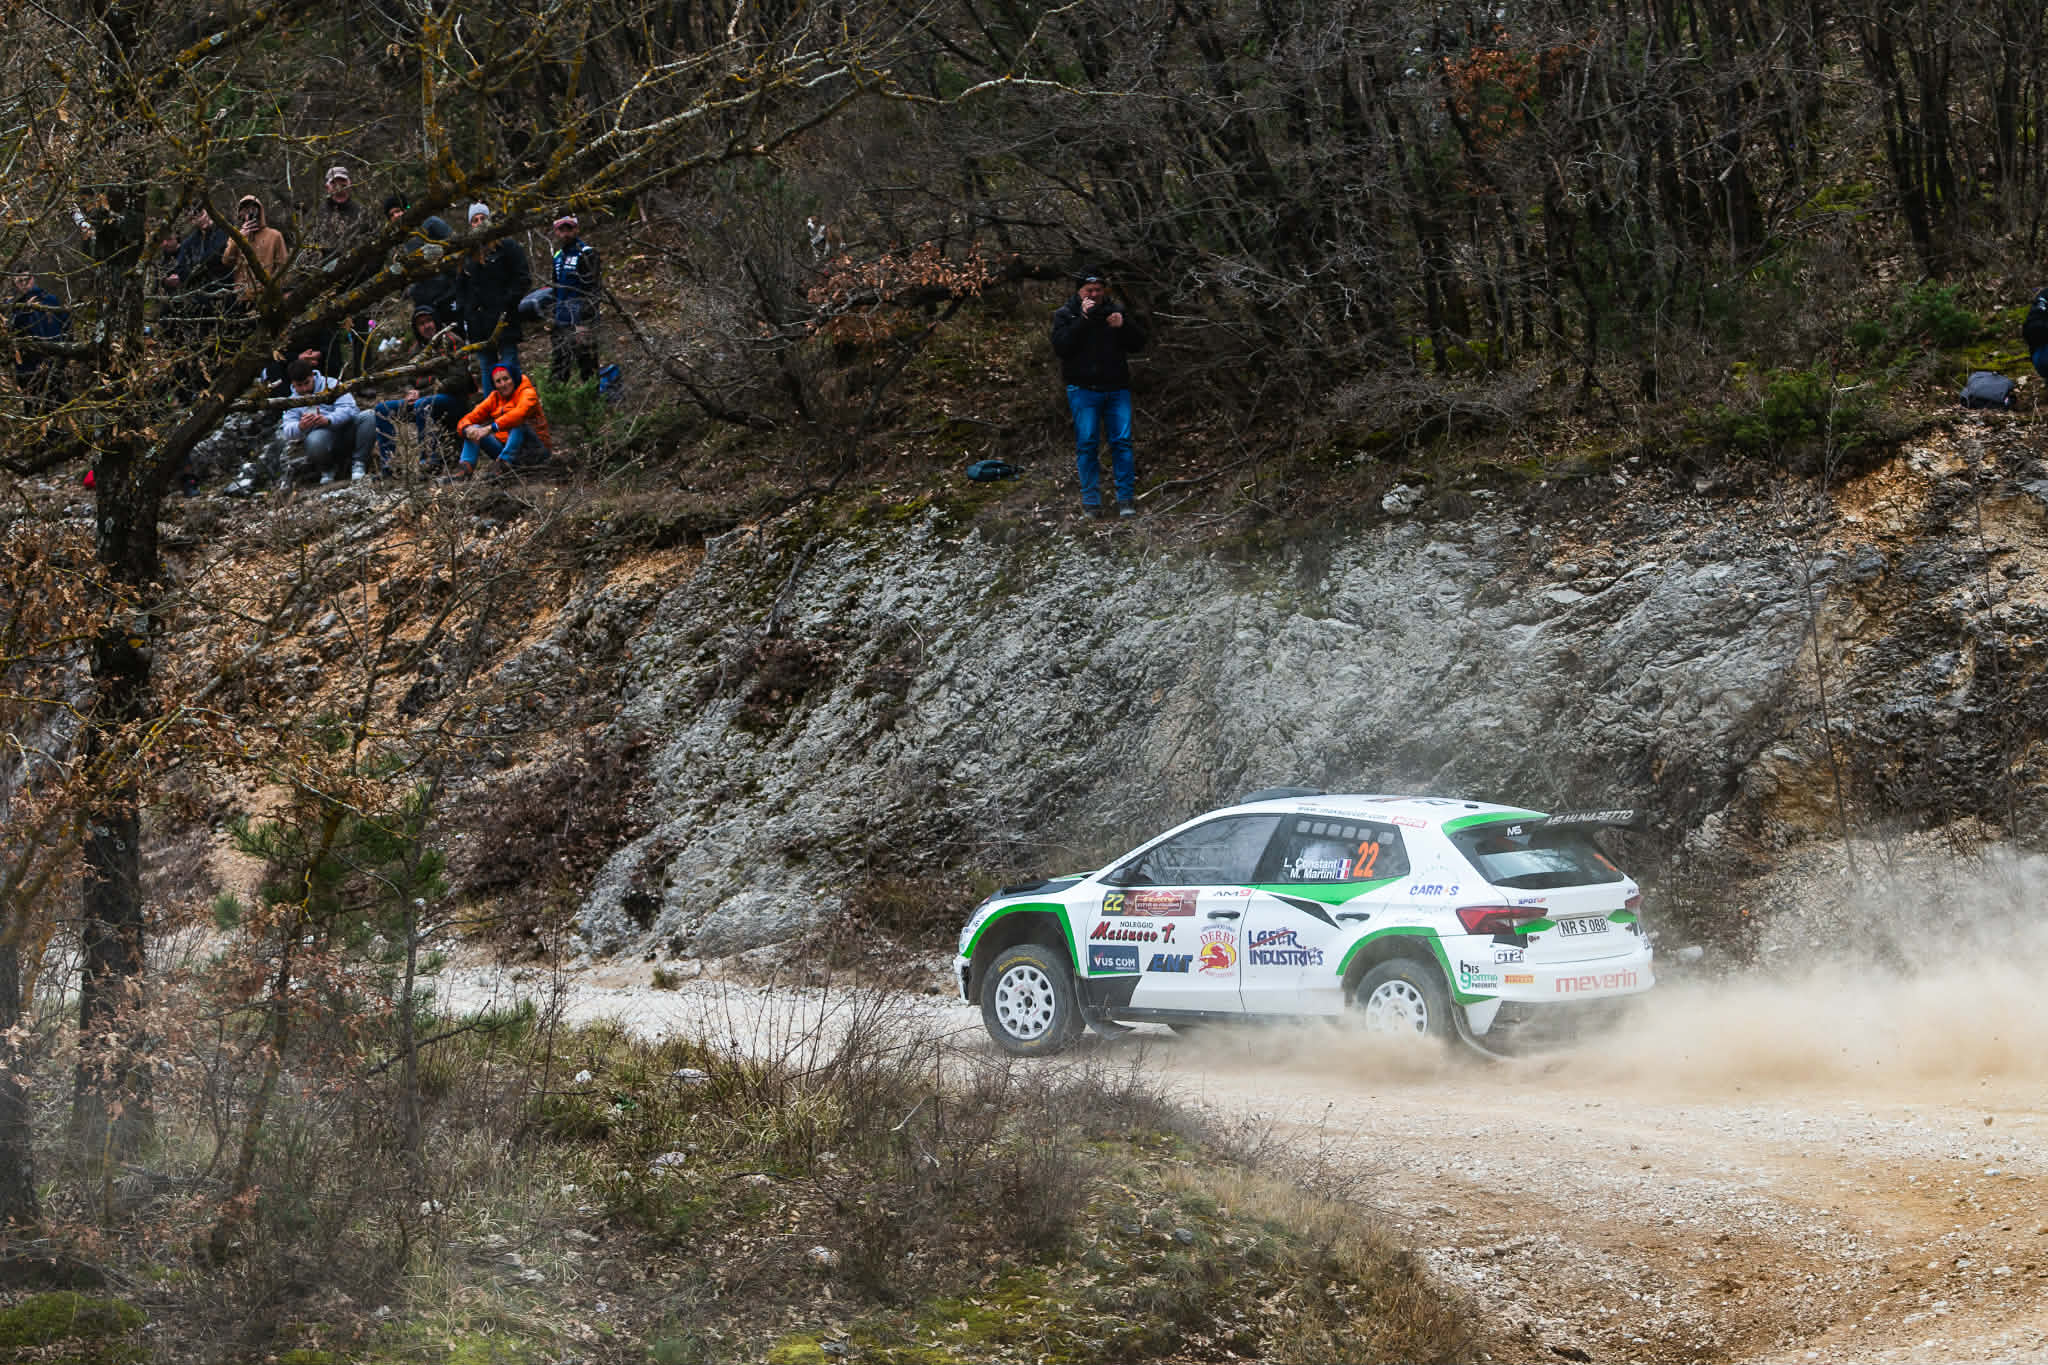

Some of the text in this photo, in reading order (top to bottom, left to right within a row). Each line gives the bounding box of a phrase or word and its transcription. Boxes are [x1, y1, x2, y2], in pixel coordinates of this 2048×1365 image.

[1283, 858, 1292, 868] L.
[1353, 841, 1380, 877] 22
[1290, 868, 1336, 880] M. Martini
[1103, 893, 1125, 911] 22
[1119, 921, 1154, 929] NOLEGGIO
[1560, 918, 1607, 935] NR S 088
[1200, 931, 1237, 945] DERBY
[1149, 953, 1193, 973] ENT
[1555, 968, 1637, 993] meverin
